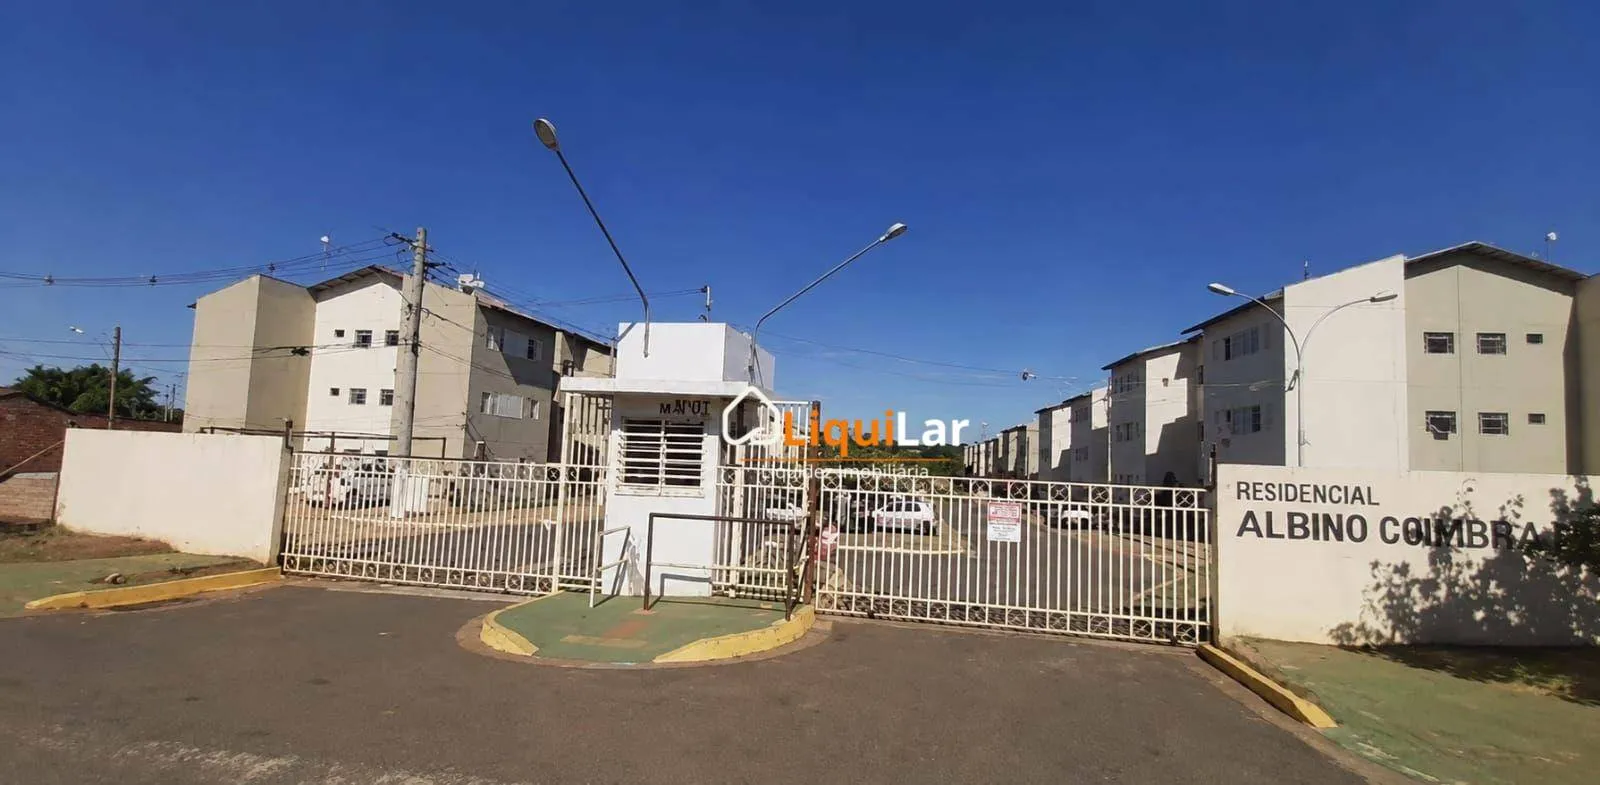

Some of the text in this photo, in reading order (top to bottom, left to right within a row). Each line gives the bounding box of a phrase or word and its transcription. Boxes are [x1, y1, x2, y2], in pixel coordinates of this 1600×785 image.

[1236, 481, 1380, 506] RESIDENCIAL
[1236, 510, 1368, 542] ALBINO
[1379, 516, 1542, 551] COIMBRA
